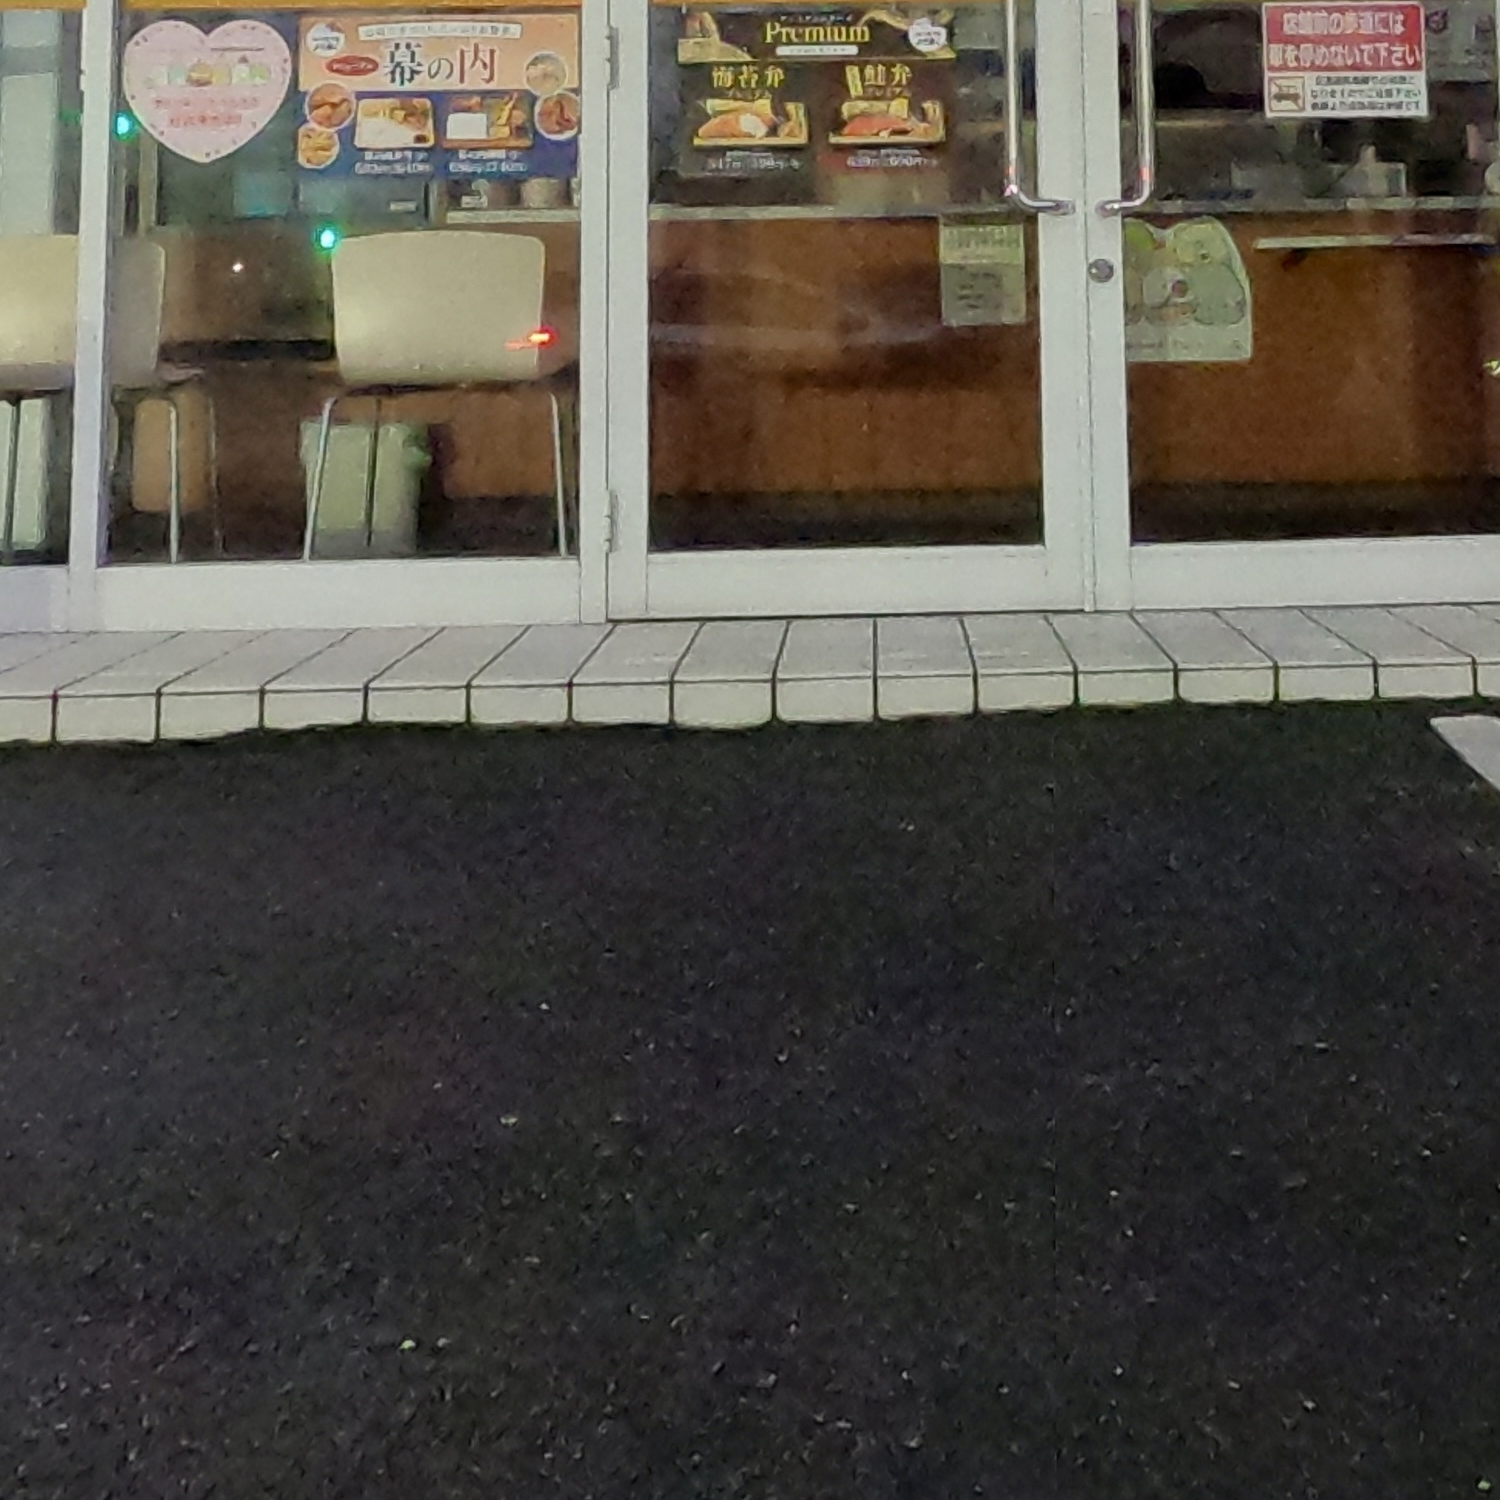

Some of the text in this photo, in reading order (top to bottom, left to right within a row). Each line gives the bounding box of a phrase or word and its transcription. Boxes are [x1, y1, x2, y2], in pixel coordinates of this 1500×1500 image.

[764, 21, 870, 44] Premium
[384, 41, 496, 86] 幕の内
